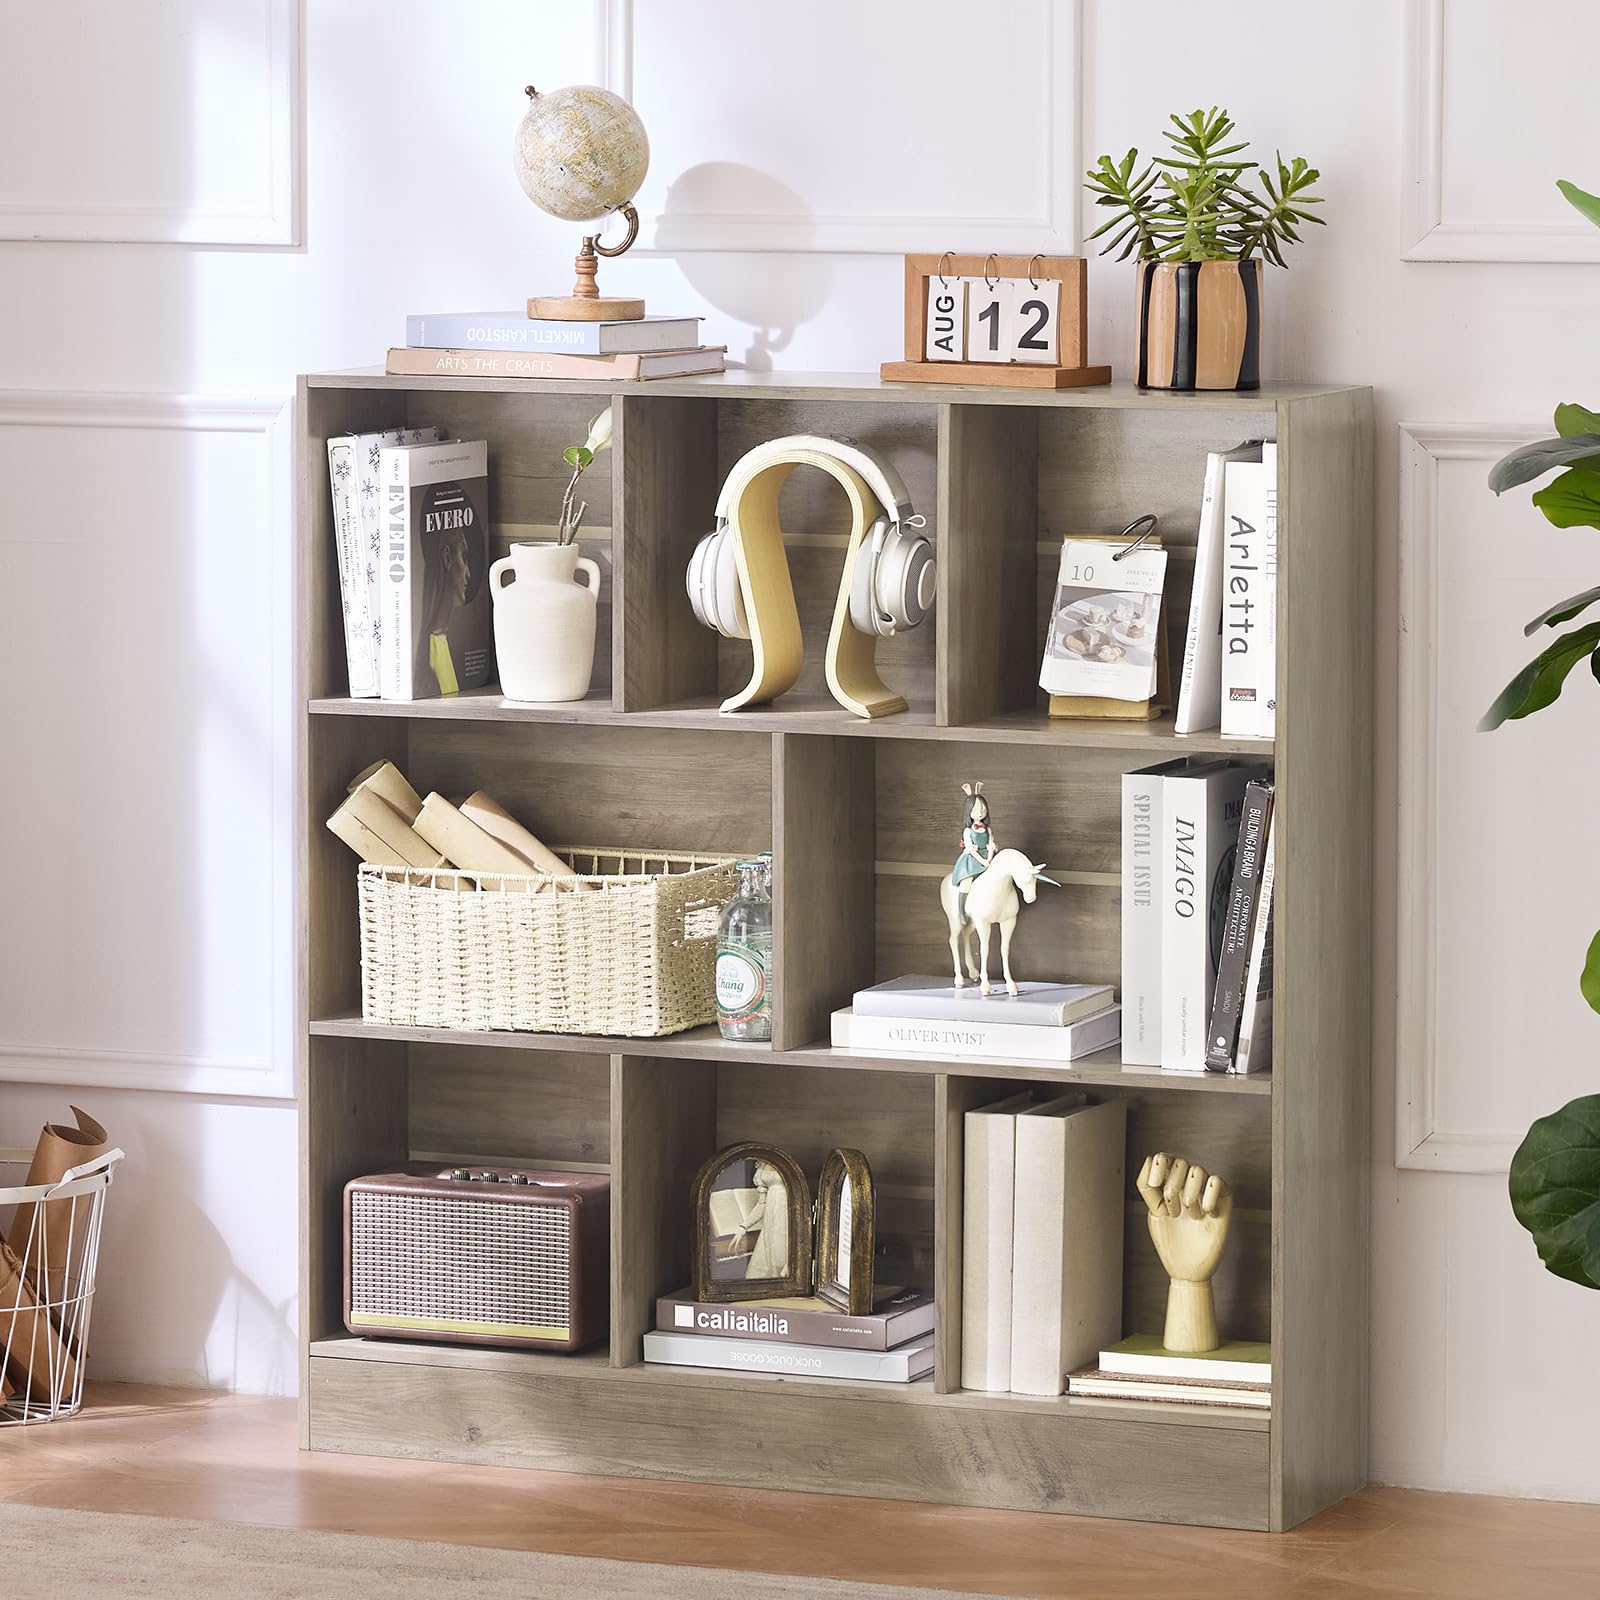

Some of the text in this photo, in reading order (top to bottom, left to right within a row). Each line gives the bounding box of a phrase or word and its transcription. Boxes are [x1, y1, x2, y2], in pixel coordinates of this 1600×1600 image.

[467, 328, 585, 345] MIKKETL KARSTOD
[934, 295, 955, 353] AUG
[436, 357, 553, 374] ARTS THE CRAFTS
[425, 506, 474, 533] EVERO
[389, 485, 405, 583] EVERO
[1071, 565, 1095, 582] 10
[1229, 515, 1258, 655] Arletta
[1133, 793, 1151, 907] SPECIAL ISSUE
[1174, 815, 1195, 919] IMAGO
[1227, 885, 1243, 954] ARCHITECTURE
[1237, 895, 1251, 949] CORPORATE
[717, 976, 744, 993] Chang
[1222, 990, 1232, 1014] SANDU
[888, 1027, 987, 1046] OLIVER TWIST
[697, 1310, 789, 1335] caliaitalia
